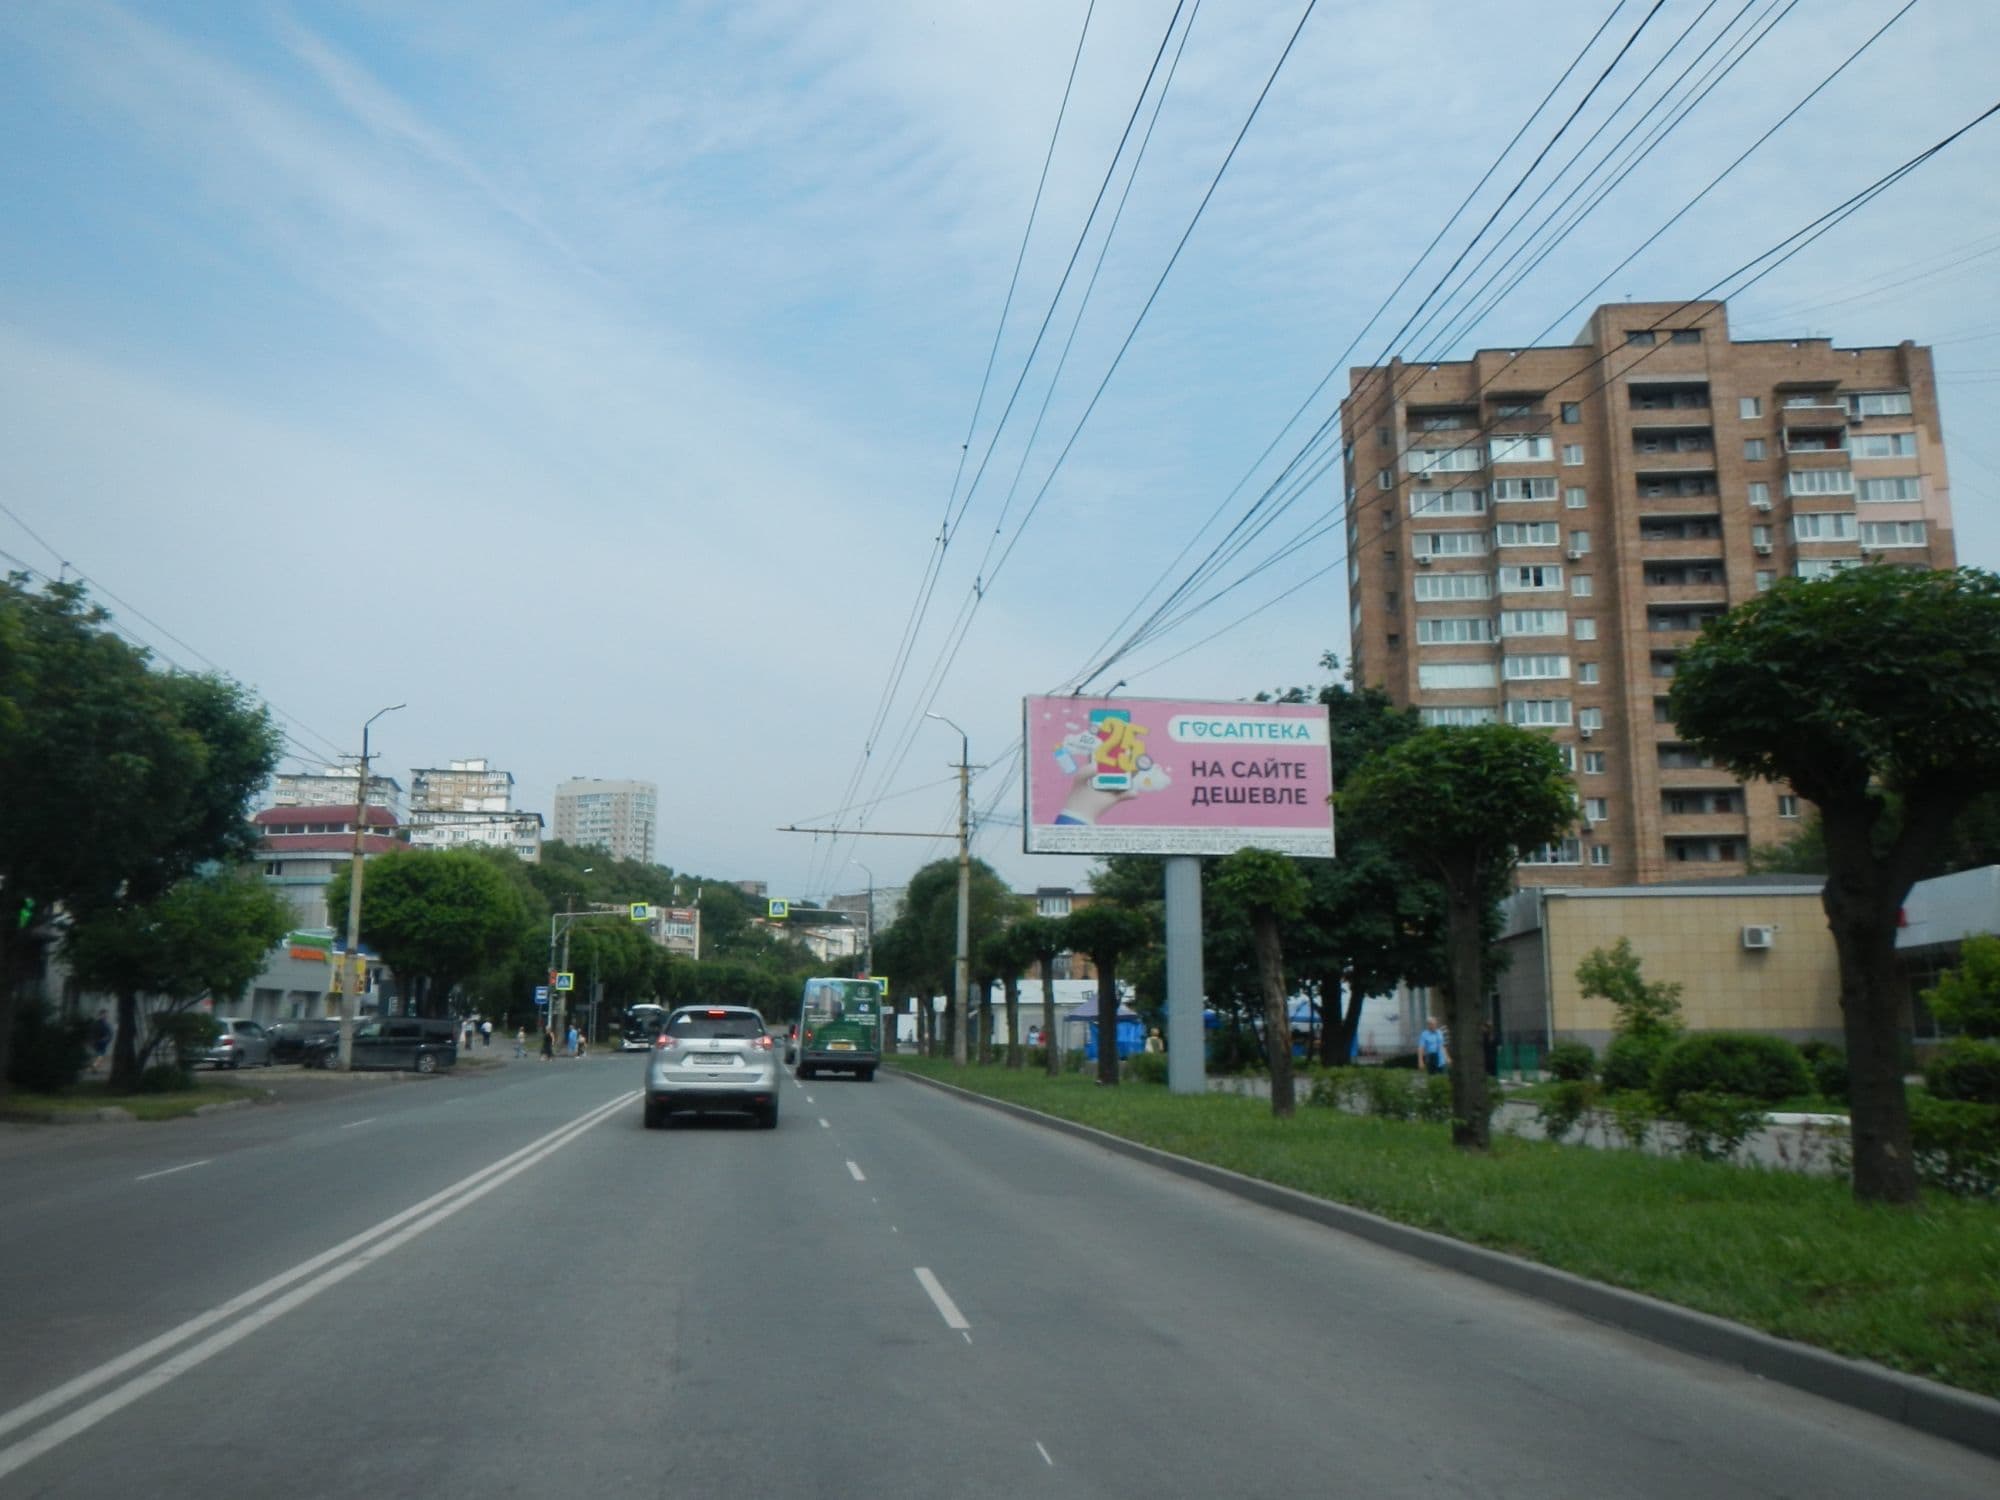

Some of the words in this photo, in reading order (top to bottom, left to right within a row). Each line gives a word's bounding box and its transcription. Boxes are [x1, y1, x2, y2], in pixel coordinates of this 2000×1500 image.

[1179, 721, 1310, 739] ГОСАПТЕКА
[1095, 717, 1150, 773] 25
[1191, 761, 1225, 778] НА
[1231, 758, 1307, 779] САЙТЕ
[1191, 786, 1307, 806] ДЕШЕВЛЕ
